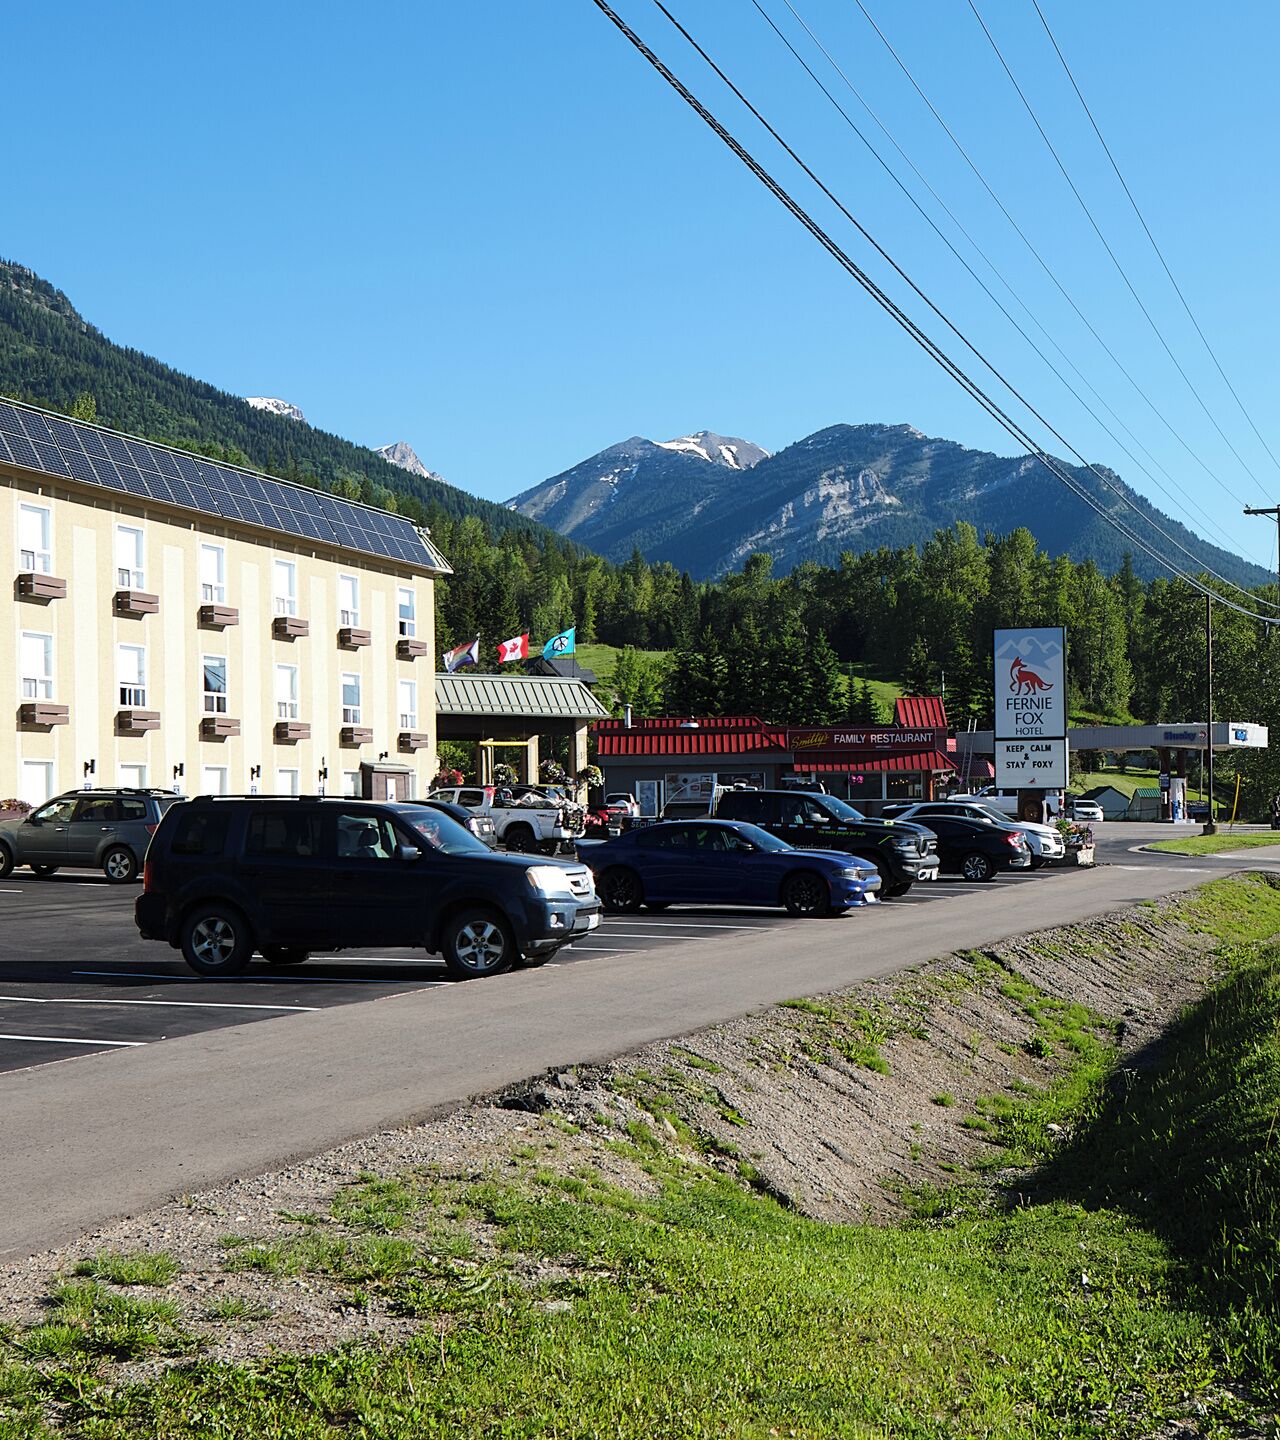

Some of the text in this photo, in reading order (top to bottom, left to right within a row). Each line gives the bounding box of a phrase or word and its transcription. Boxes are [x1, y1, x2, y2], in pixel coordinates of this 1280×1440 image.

[1006, 697, 1052, 710] FERNIE
[1015, 712, 1044, 725] FOX
[1015, 727, 1044, 735] HOTEL
[791, 732, 933, 748] Smitty's FAMILY RESTAURANT
[1006, 744, 1052, 752] KEEP CALM
[1006, 761, 1026, 769] STAY
